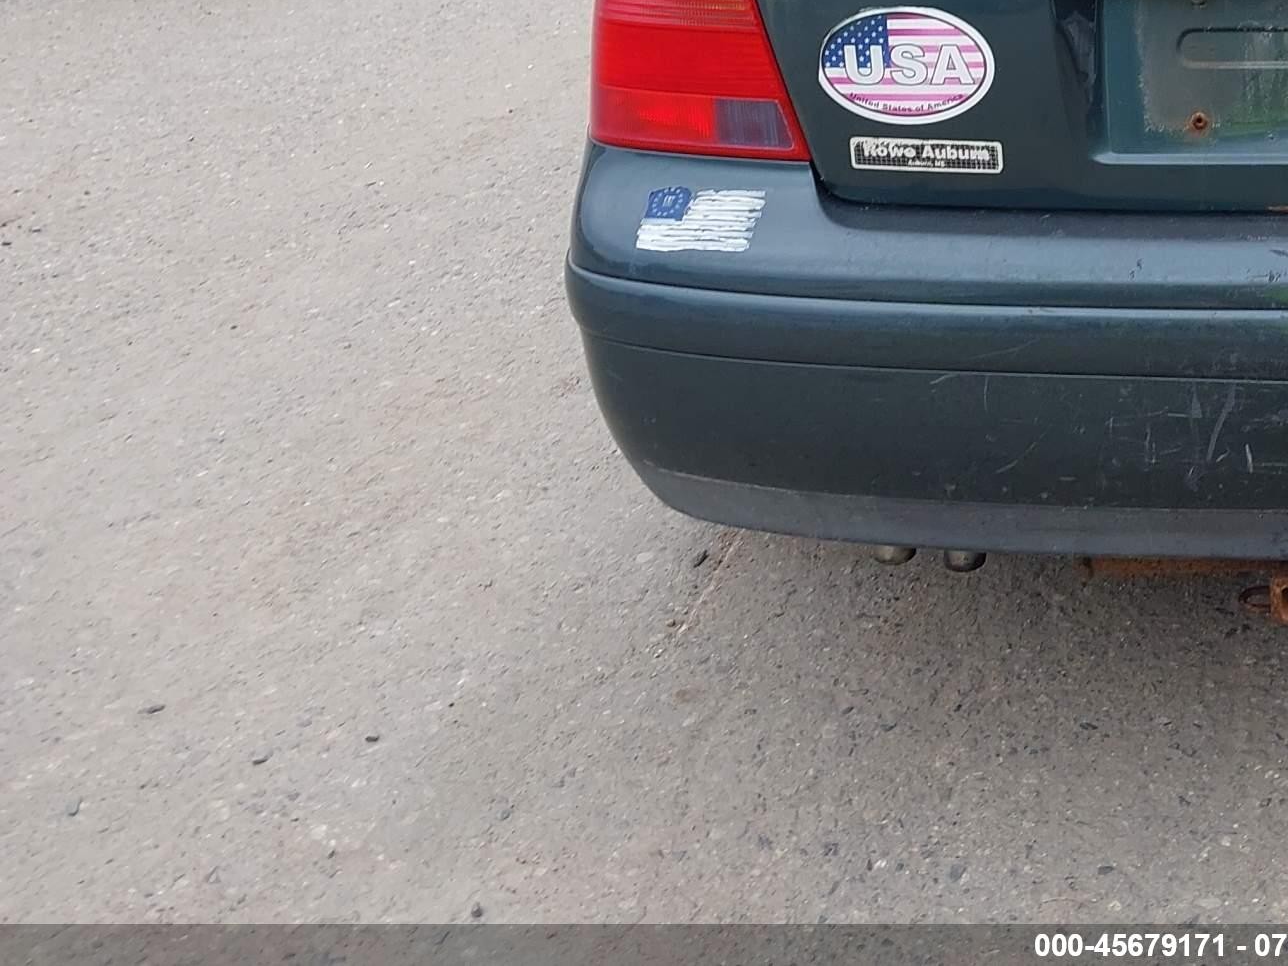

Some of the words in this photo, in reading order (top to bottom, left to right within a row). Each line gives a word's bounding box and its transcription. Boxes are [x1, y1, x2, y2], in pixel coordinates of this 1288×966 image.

[843, 43, 976, 86] USA
[847, 92, 880, 109] United
[882, 103, 913, 113] States
[915, 104, 924, 112] of
[927, 93, 965, 112] America
